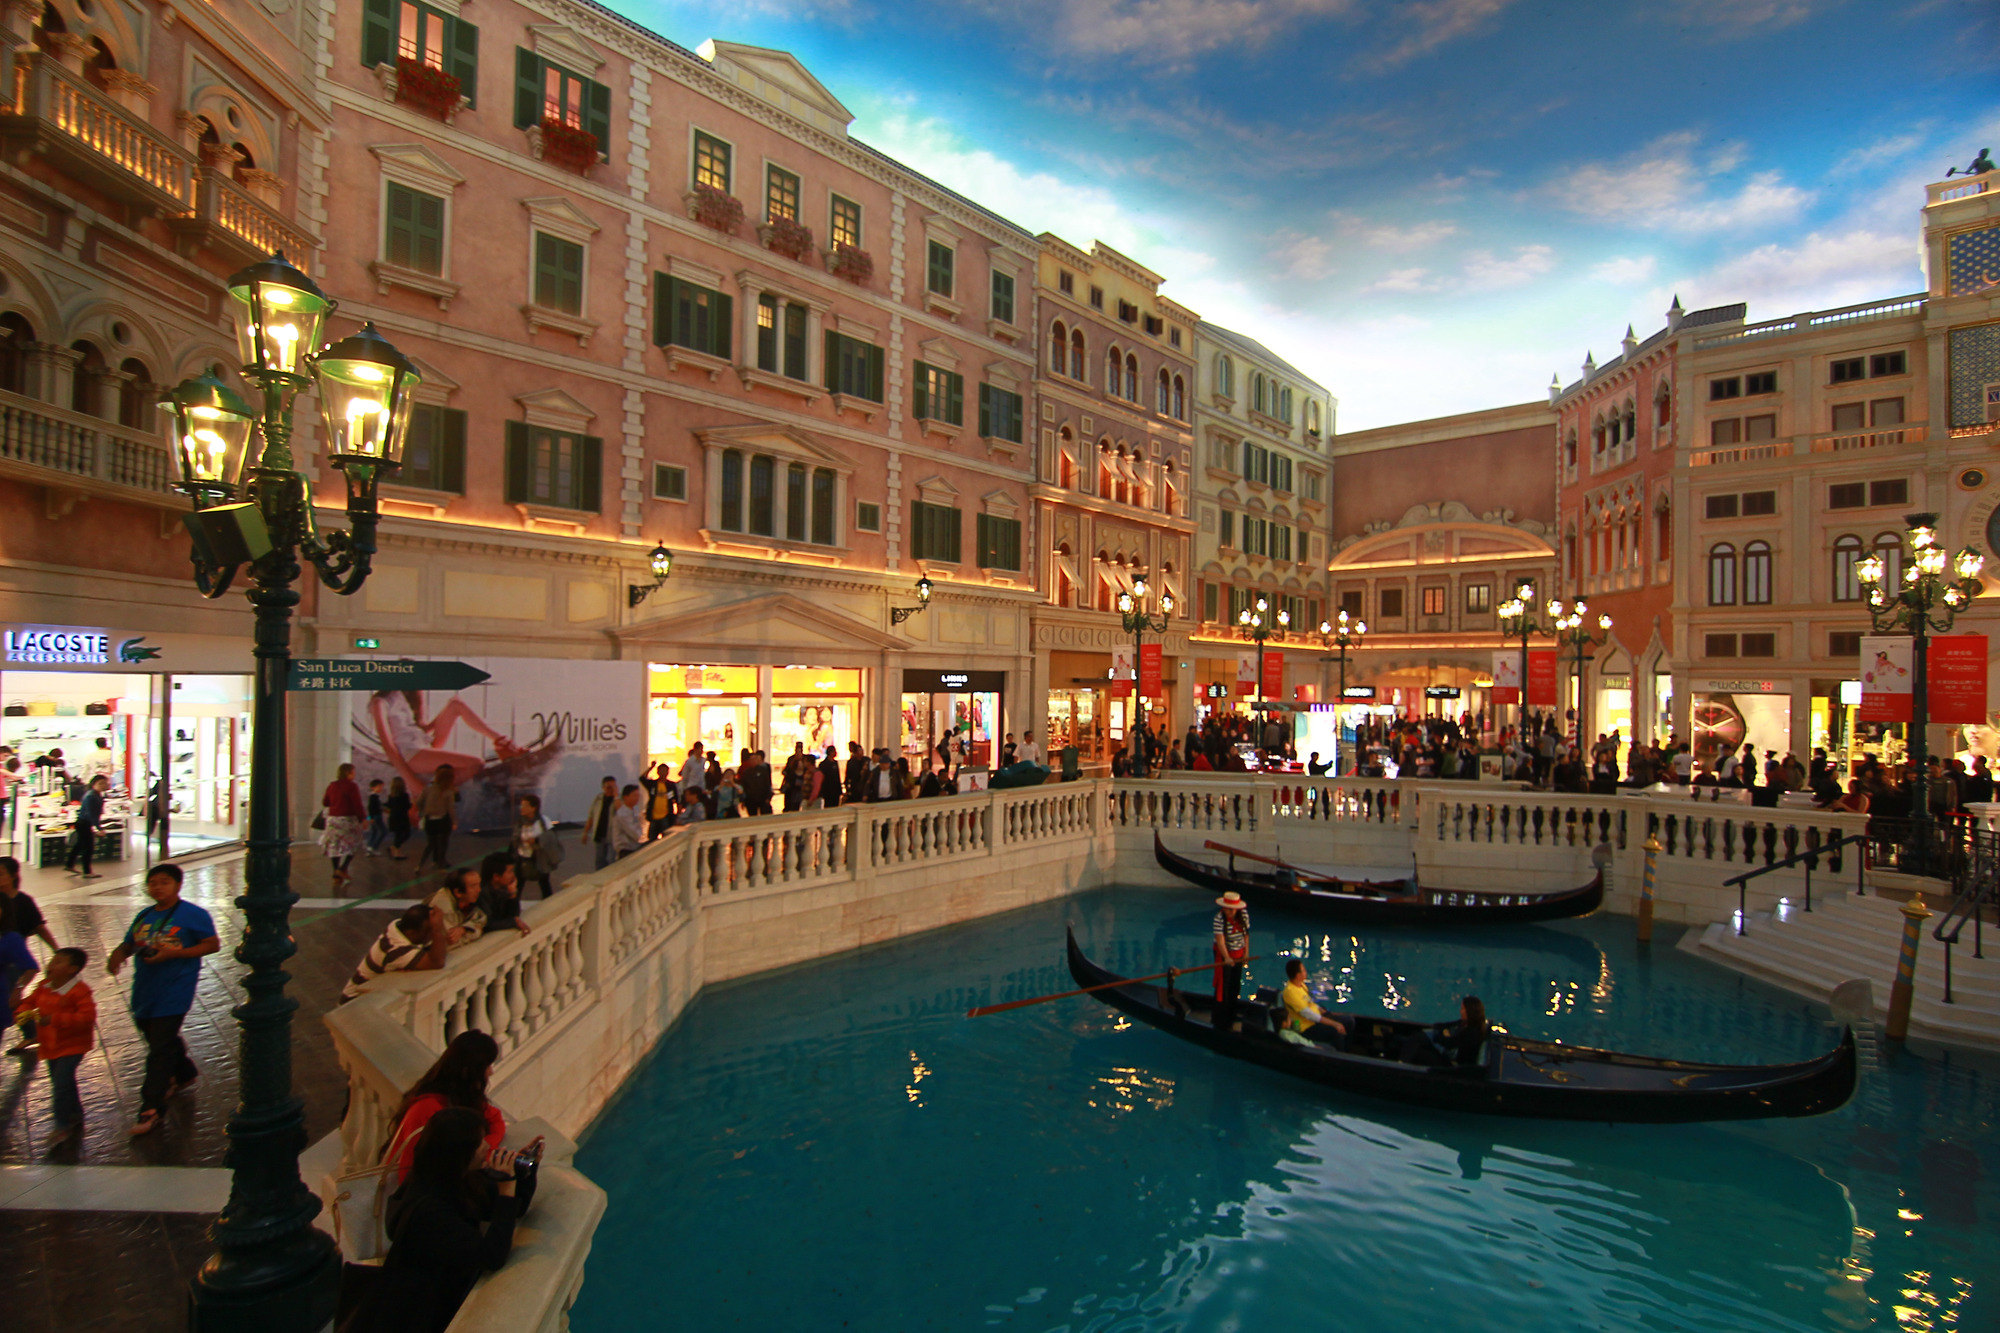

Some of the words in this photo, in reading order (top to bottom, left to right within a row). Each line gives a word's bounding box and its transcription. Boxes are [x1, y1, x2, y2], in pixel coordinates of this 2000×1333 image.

[8, 631, 108, 652] LACOSTE
[298, 660, 324, 672] San
[329, 661, 361, 672] Luca
[365, 661, 413, 673] District
[531, 711, 627, 744] Millie's
